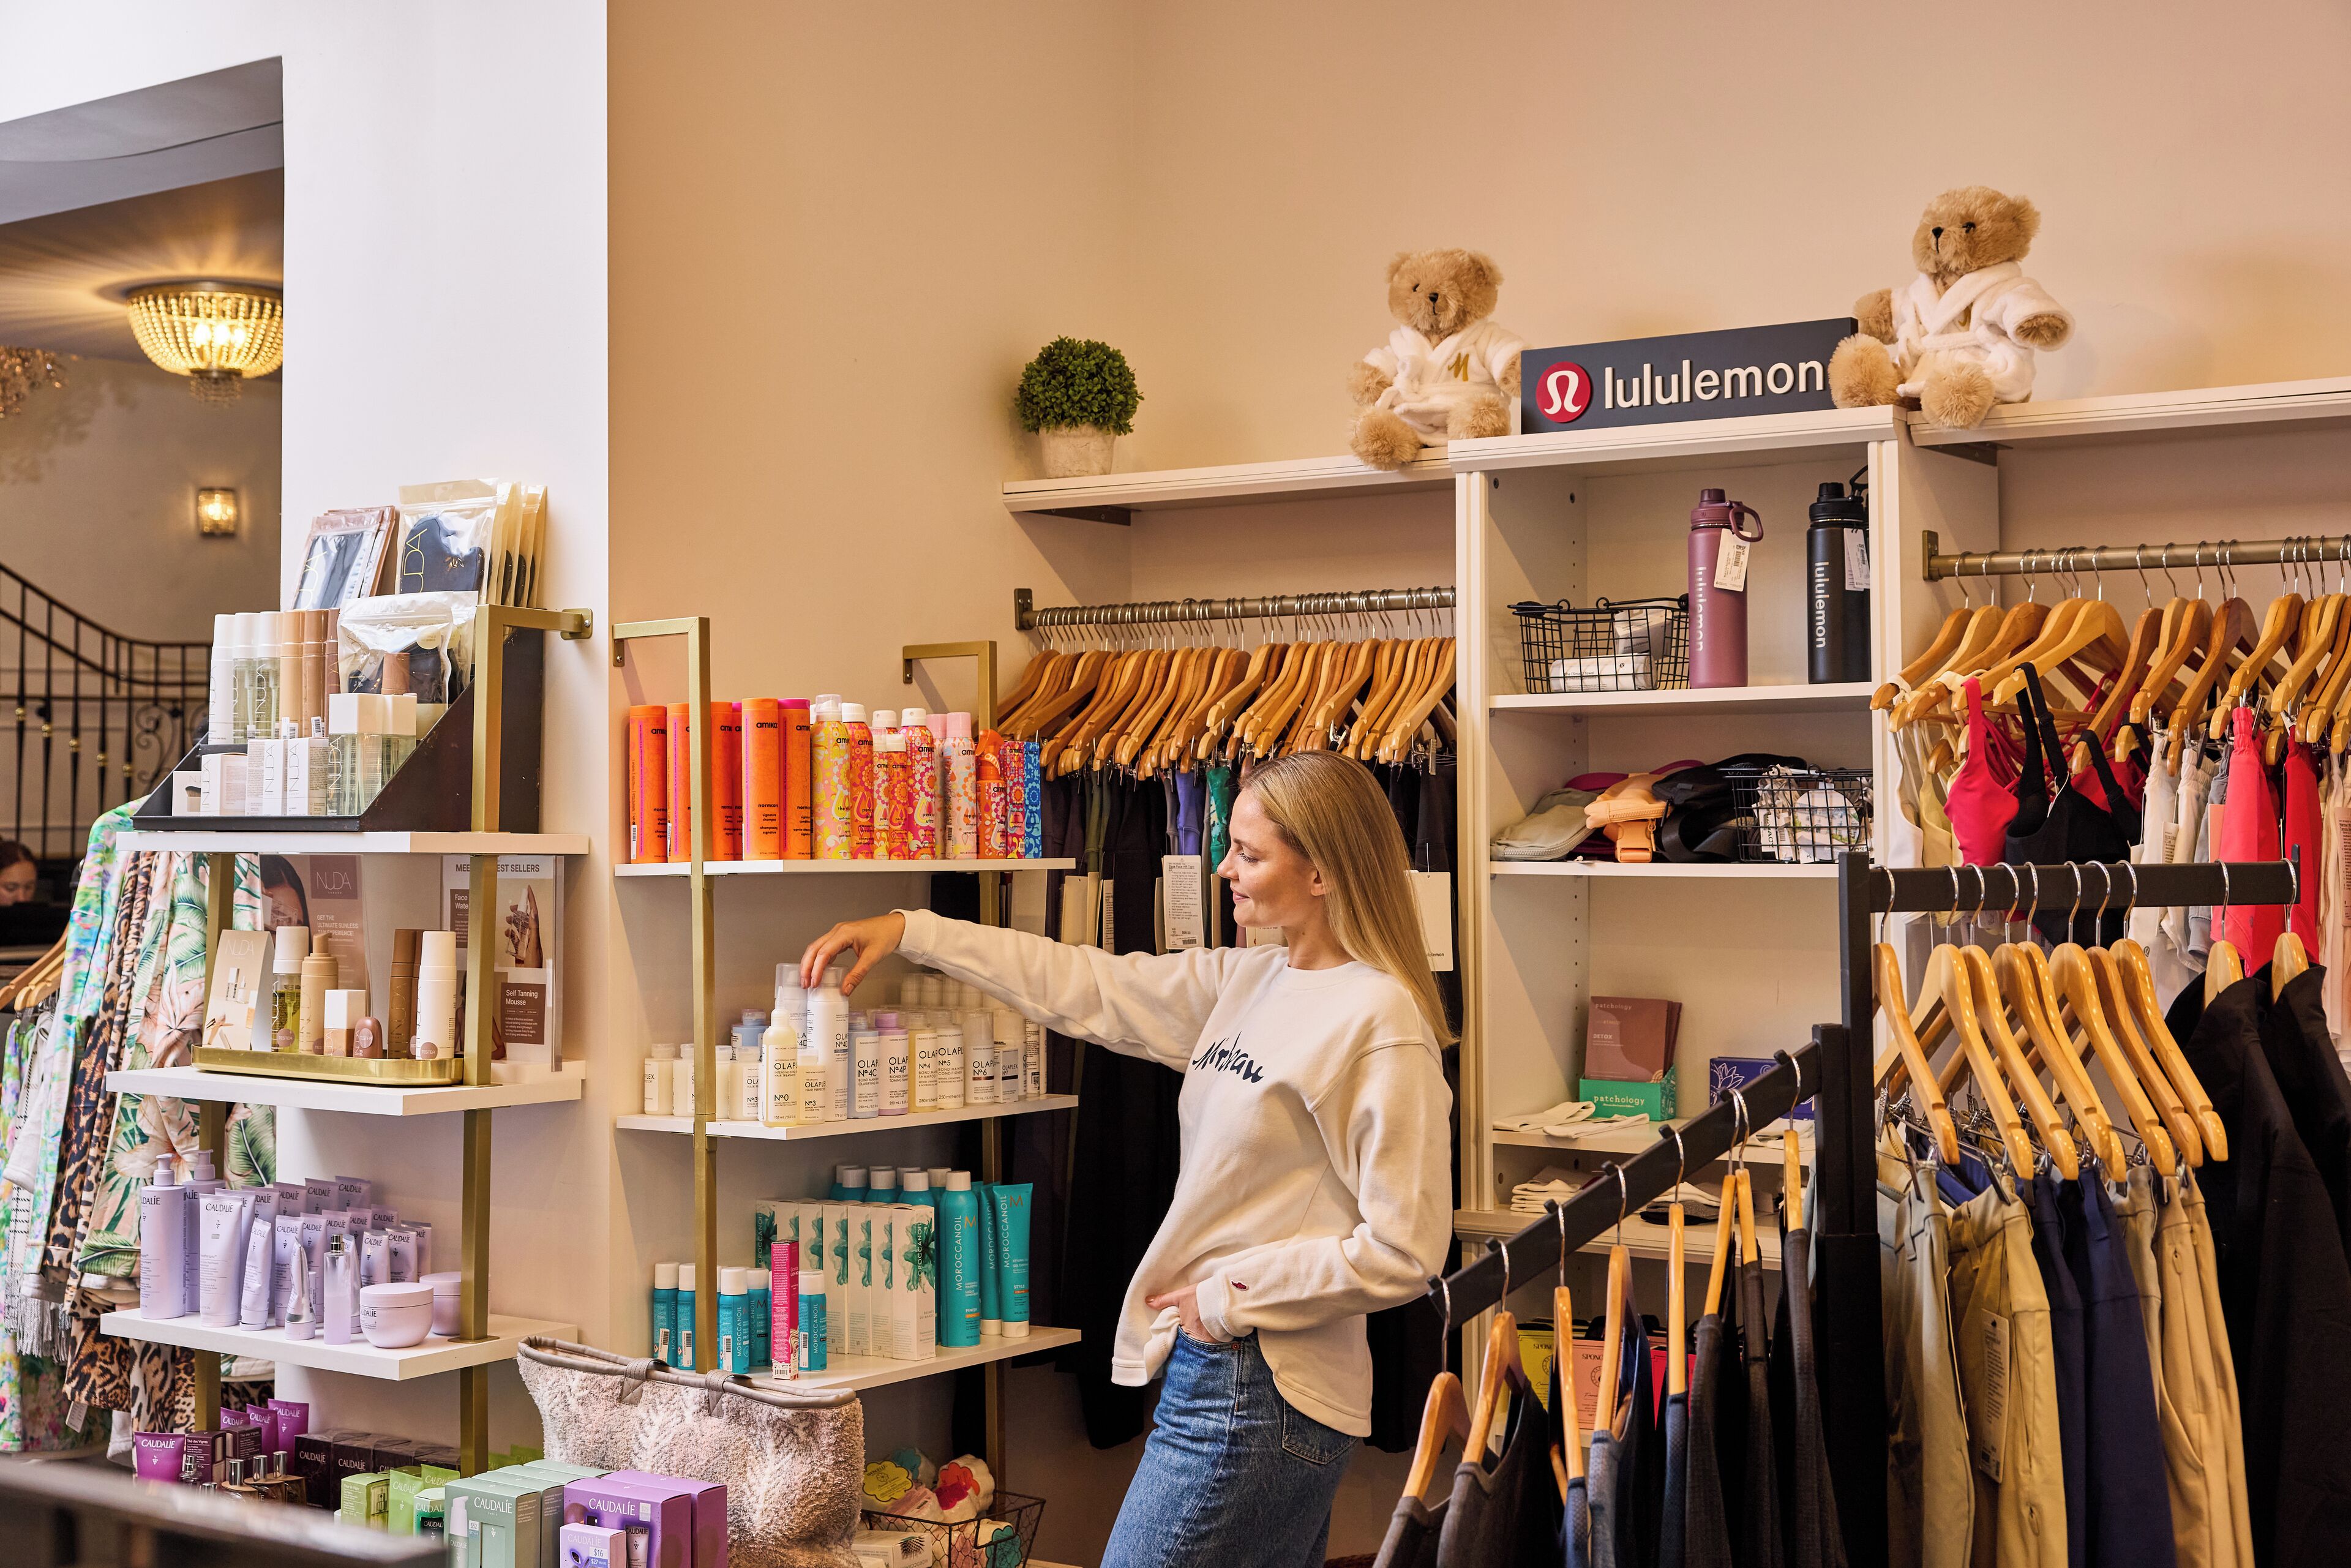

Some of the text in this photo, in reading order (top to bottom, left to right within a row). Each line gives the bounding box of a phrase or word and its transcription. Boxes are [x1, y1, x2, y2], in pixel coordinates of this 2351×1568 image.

[1604, 359, 1824, 410] lululemon
[1695, 566, 1708, 653] lululemon
[1815, 561, 1829, 648] lululemon
[264, 744, 275, 792] NUDA
[289, 743, 299, 792] NUDA
[329, 735, 345, 789] NUDA
[456, 864, 470, 872] MEE
[510, 864, 540, 872] SELLERS
[317, 871, 352, 890] NUDA
[225, 940, 255, 955] NUDA
[517, 990, 538, 999] Tanning
[391, 983, 407, 1035] NUDA
[1594, 1095, 1645, 1105] patchology
[307, 1186, 331, 1197] CAUDALÍE
[339, 1183, 362, 1193] CAUDALÍE
[205, 1202, 234, 1213] CAUDALÍE
[373, 1213, 395, 1223] CAUDALÍE
[276, 1225, 299, 1234] CAUDALÍE
[1000, 1195, 1010, 1268] MOROCCANOIL
[364, 1237, 383, 1247] CAUDALÍE
[388, 1233, 411, 1244] CAUDALÍE
[249, 1412, 271, 1424] CAUDALÍE
[141, 1438, 176, 1449] CAUDALÍE
[299, 1450, 326, 1463] CAUDALÍE
[338, 1458, 366, 1470] CAUDALÍE
[392, 1481, 417, 1495] CAUDALÍE
[416, 1502, 445, 1513] CAUDAL
[474, 1497, 513, 1514] CAUDALÍE
[588, 1498, 636, 1516] CAUDALÍE
[451, 1539, 467, 1549] CAUDALÍE
[568, 1533, 602, 1547] CAUDALÍE
[594, 1548, 604, 1557] $16
